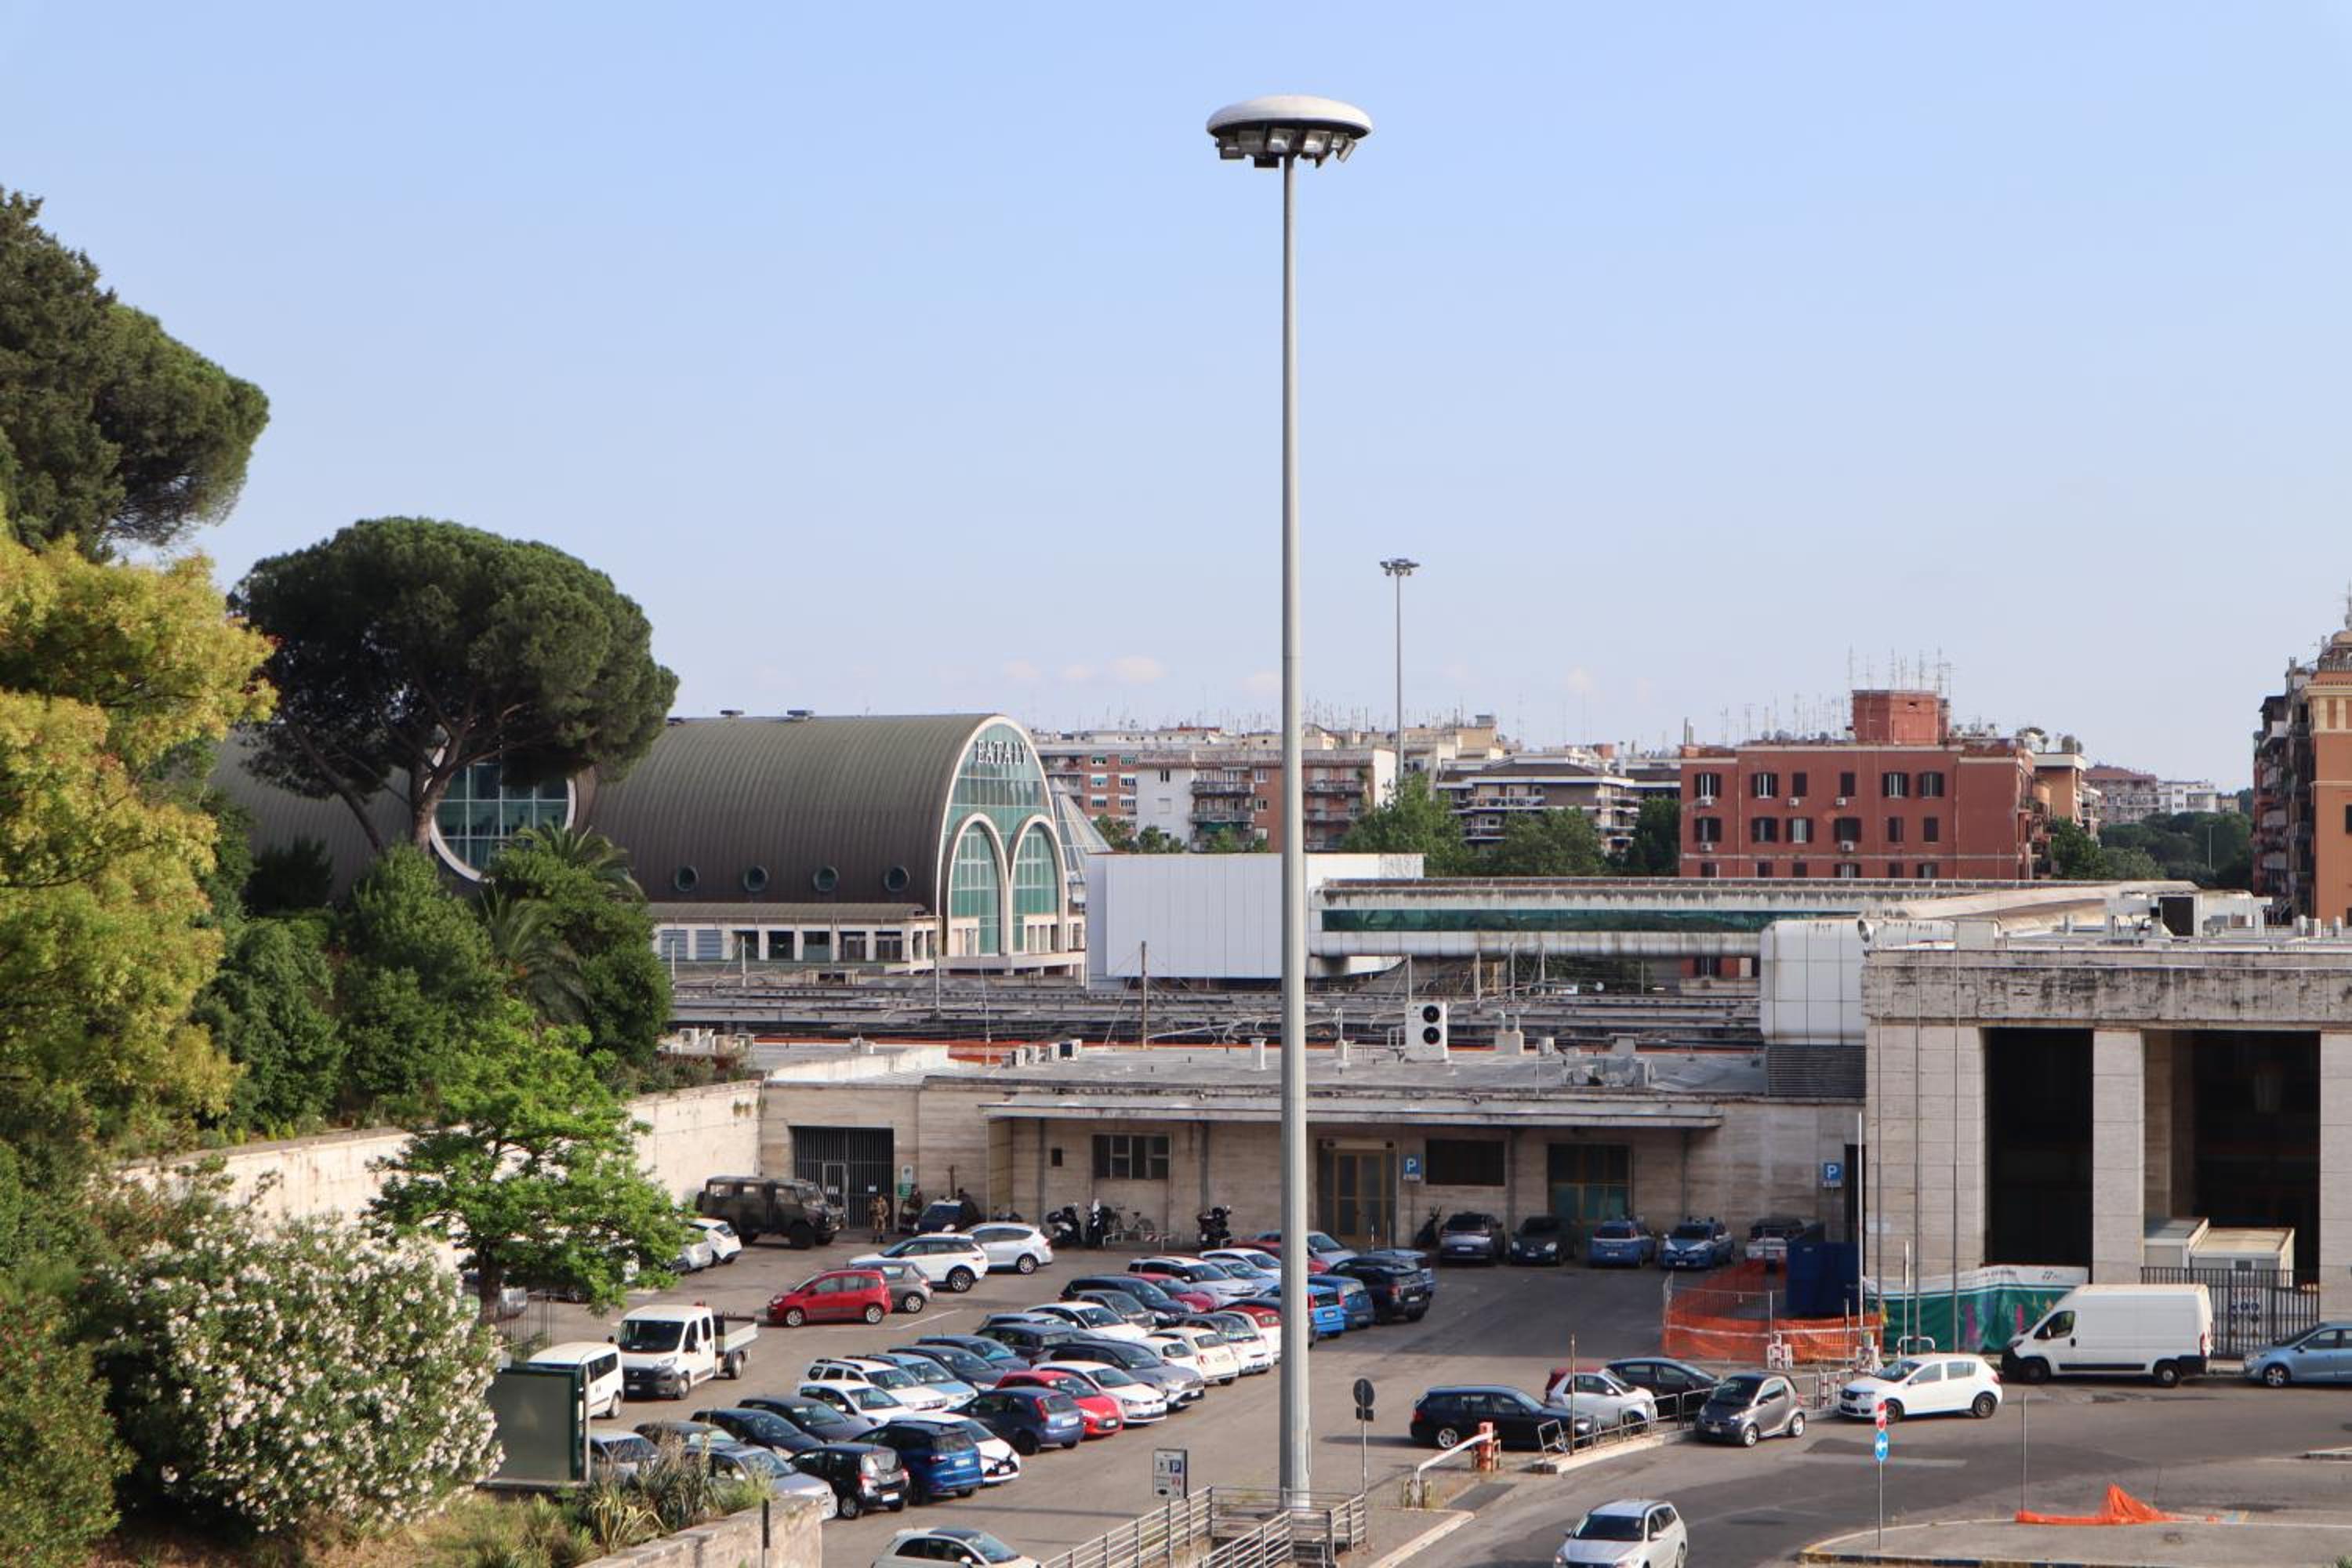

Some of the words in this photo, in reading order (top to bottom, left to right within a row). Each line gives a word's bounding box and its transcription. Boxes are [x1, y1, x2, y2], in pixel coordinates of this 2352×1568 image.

[977, 740, 1028, 765] EATALY
[1406, 1157, 1417, 1174] P
[1828, 1164, 1838, 1179] P
